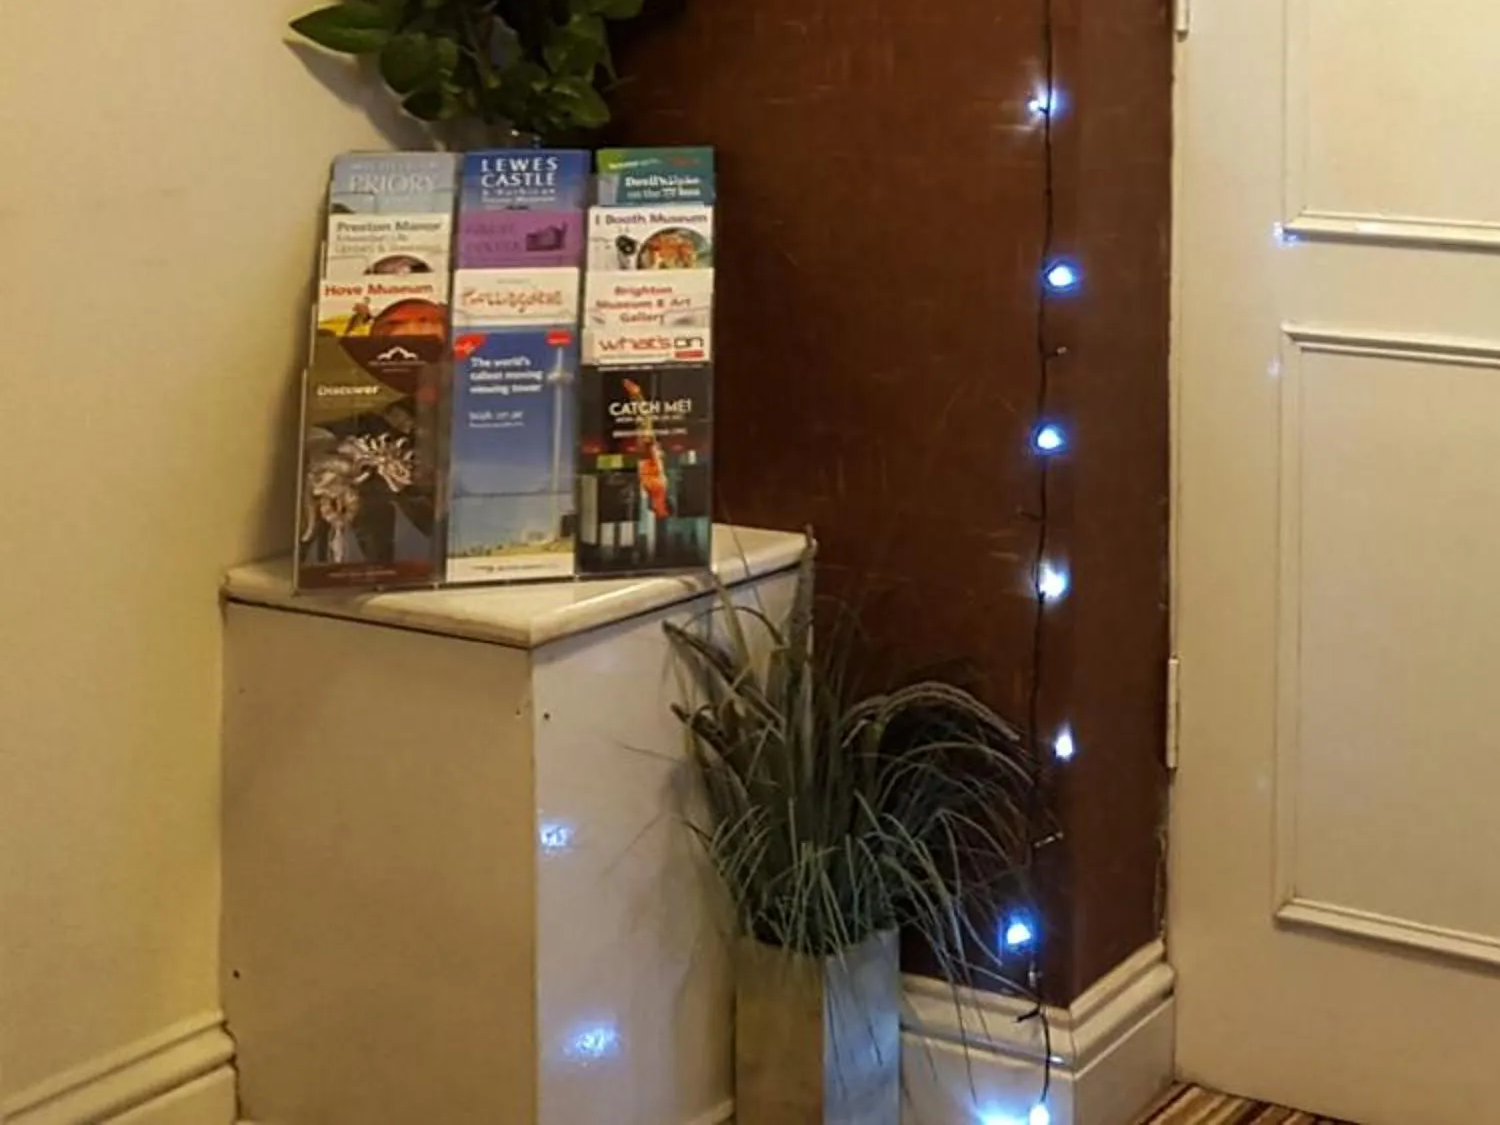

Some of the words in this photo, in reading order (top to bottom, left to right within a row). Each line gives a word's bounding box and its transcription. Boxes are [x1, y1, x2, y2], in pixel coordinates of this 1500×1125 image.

[481, 157, 559, 172] LEWES
[480, 172, 556, 187] CASTLE
[605, 214, 647, 225] Booth
[649, 212, 708, 224] Museum
[395, 220, 441, 231] Manor
[324, 284, 362, 296] Hove
[367, 283, 433, 295] Museum
[614, 285, 672, 297] Brighton
[596, 299, 653, 310] Museum
[670, 298, 691, 307] Art
[619, 312, 665, 325] Gallery
[599, 335, 672, 351] what's
[608, 401, 660, 416] CATCH
[664, 398, 692, 414] ME!
